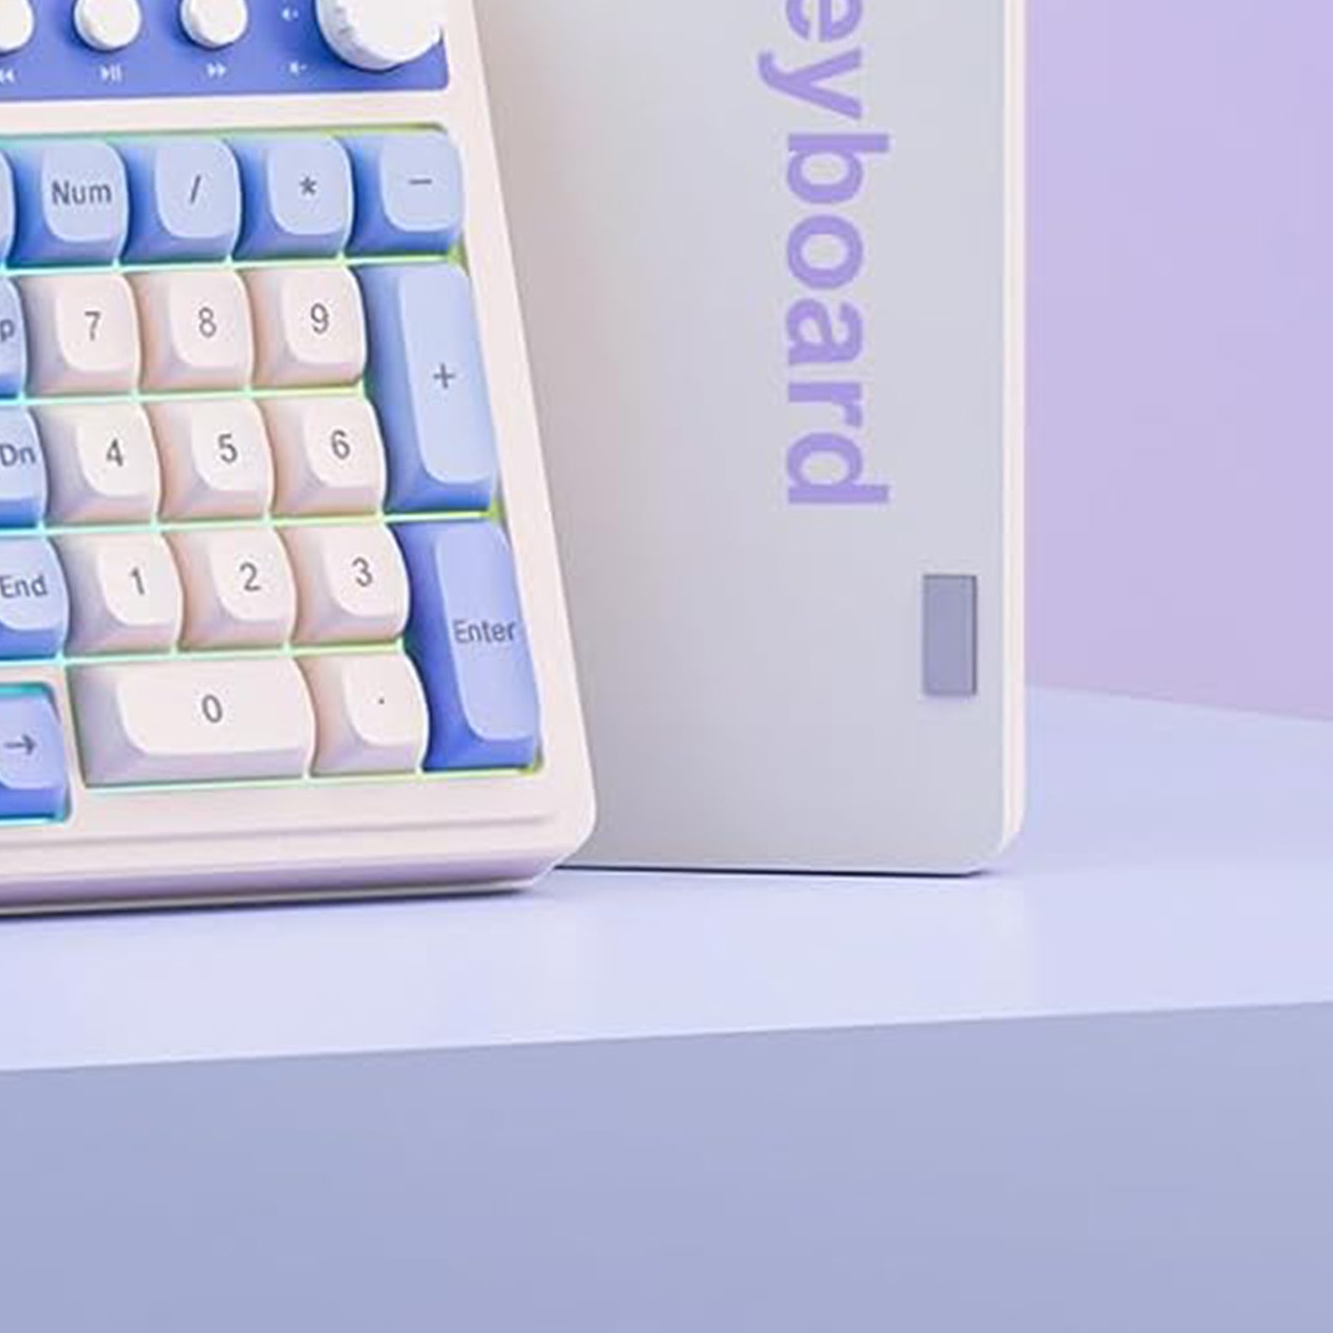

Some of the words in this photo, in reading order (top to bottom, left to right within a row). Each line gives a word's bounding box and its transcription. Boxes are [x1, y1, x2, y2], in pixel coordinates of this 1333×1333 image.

[52, 181, 111, 205] Num
[190, 175, 201, 203] /
[85, 311, 100, 340] 7
[199, 307, 216, 338] 8
[311, 303, 329, 334] 9
[107, 439, 123, 466] 4
[218, 434, 237, 463] 5
[331, 430, 350, 459] 6
[131, 568, 144, 594] 1
[240, 562, 261, 591] 2
[352, 557, 373, 587] 3
[453, 620, 515, 644] Enter
[202, 695, 222, 723] 0
